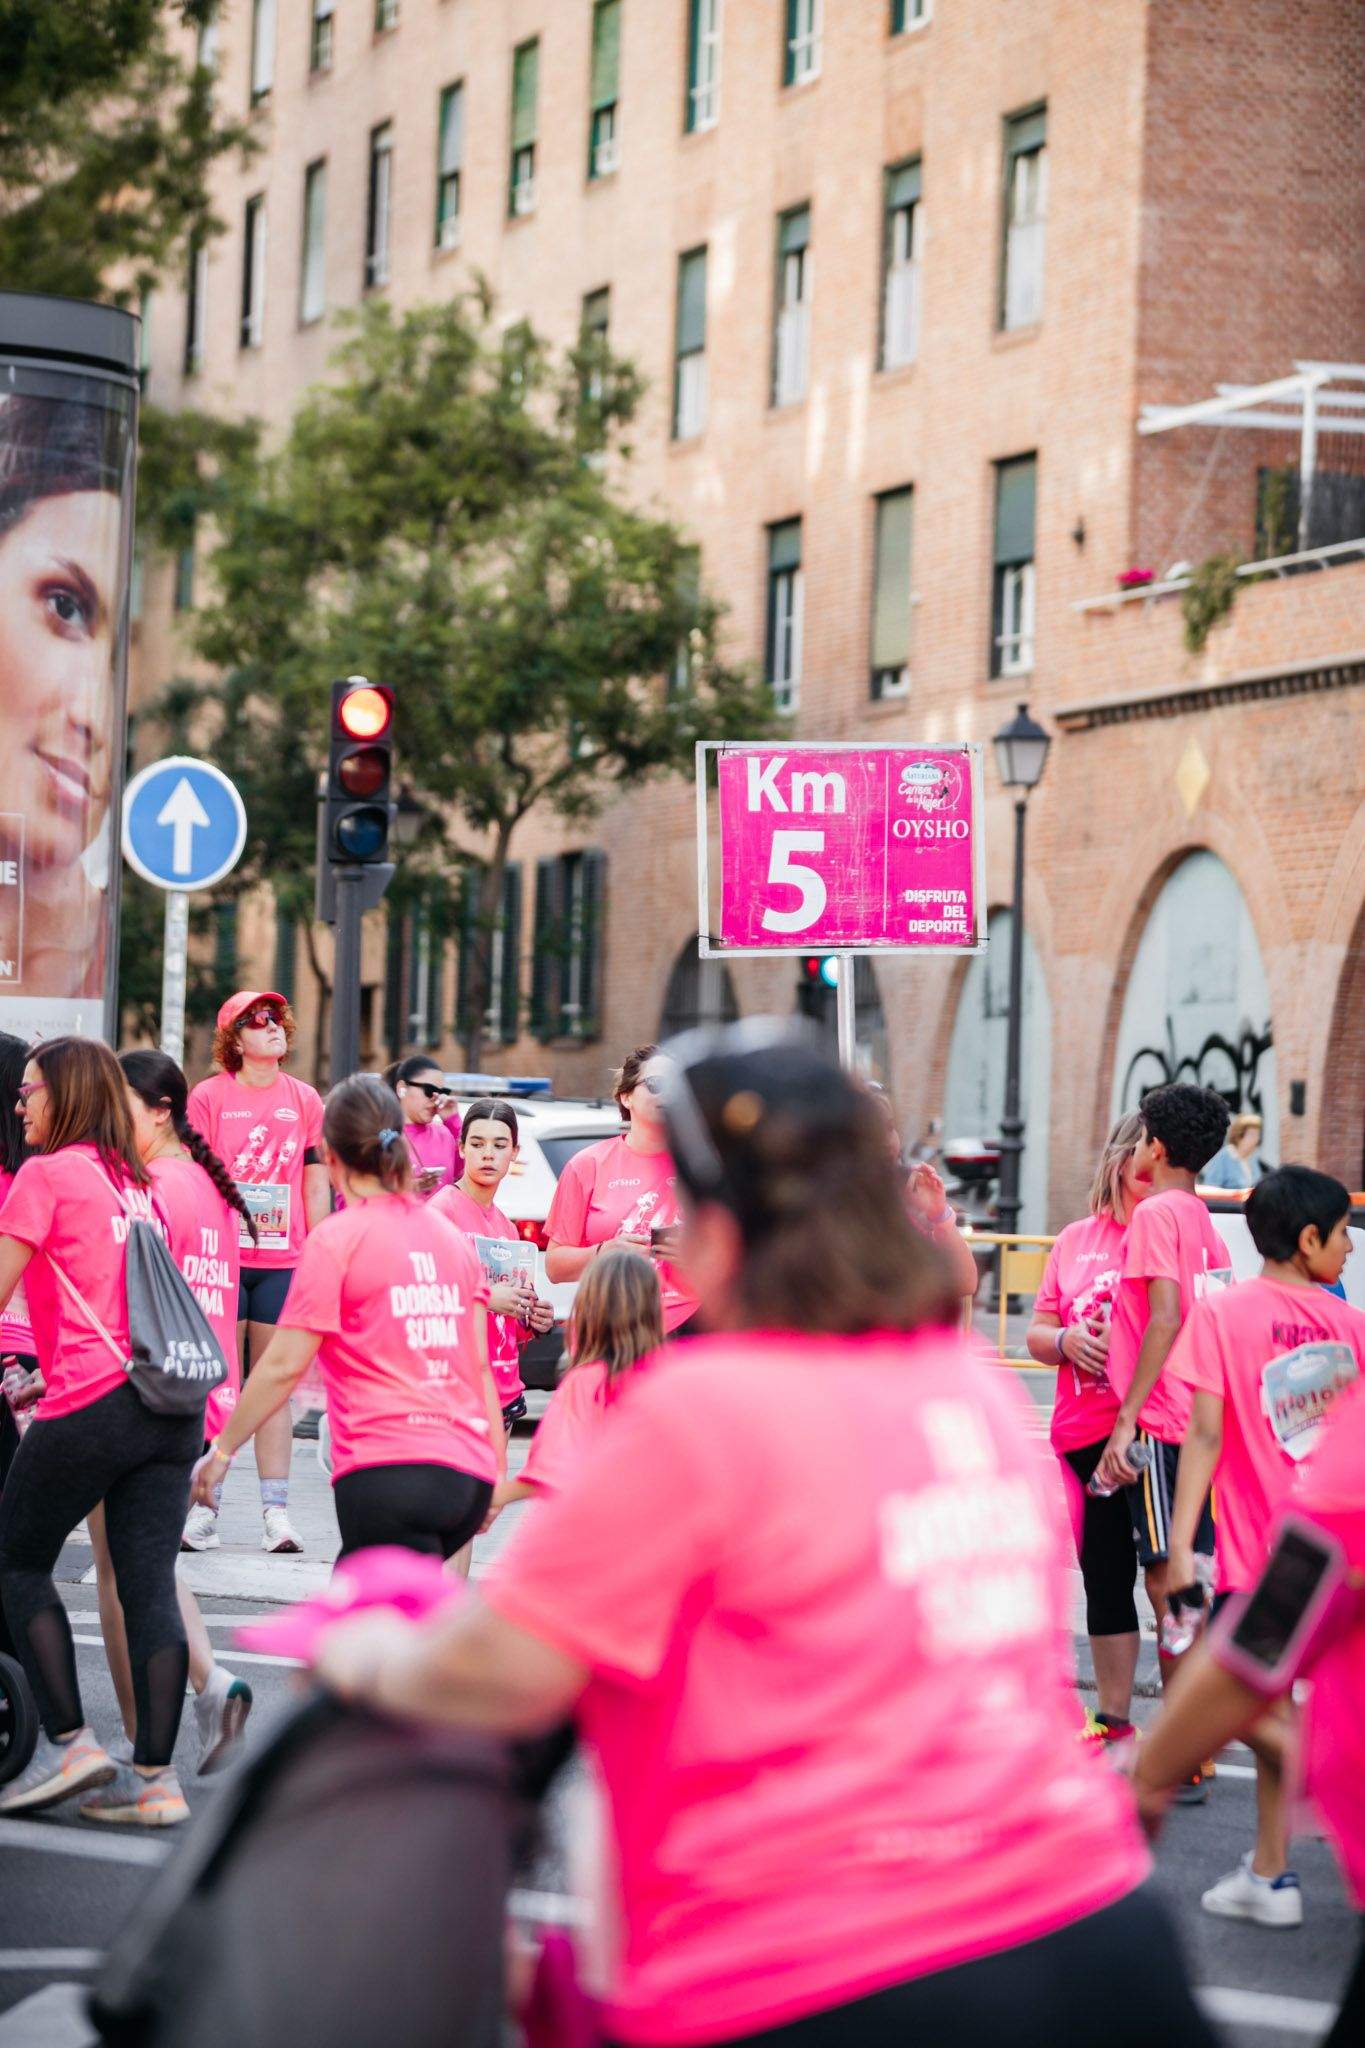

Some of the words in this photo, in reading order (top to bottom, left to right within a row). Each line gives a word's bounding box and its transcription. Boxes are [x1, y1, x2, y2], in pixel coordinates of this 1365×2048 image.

[747, 756, 846, 813] Km
[893, 819, 969, 838] OYSHO
[761, 830, 827, 933] 5
[905, 889, 967, 903] DISFRUTA
[943, 905, 967, 918] DEL
[909, 920, 967, 933] DEPORTE
[608, 1178, 640, 1189] OYSHO
[200, 1227, 219, 1256] TU
[409, 1251, 437, 1283] TU
[390, 1283, 466, 1318] DORSAL
[163, 1355, 223, 1380] PLAYER
